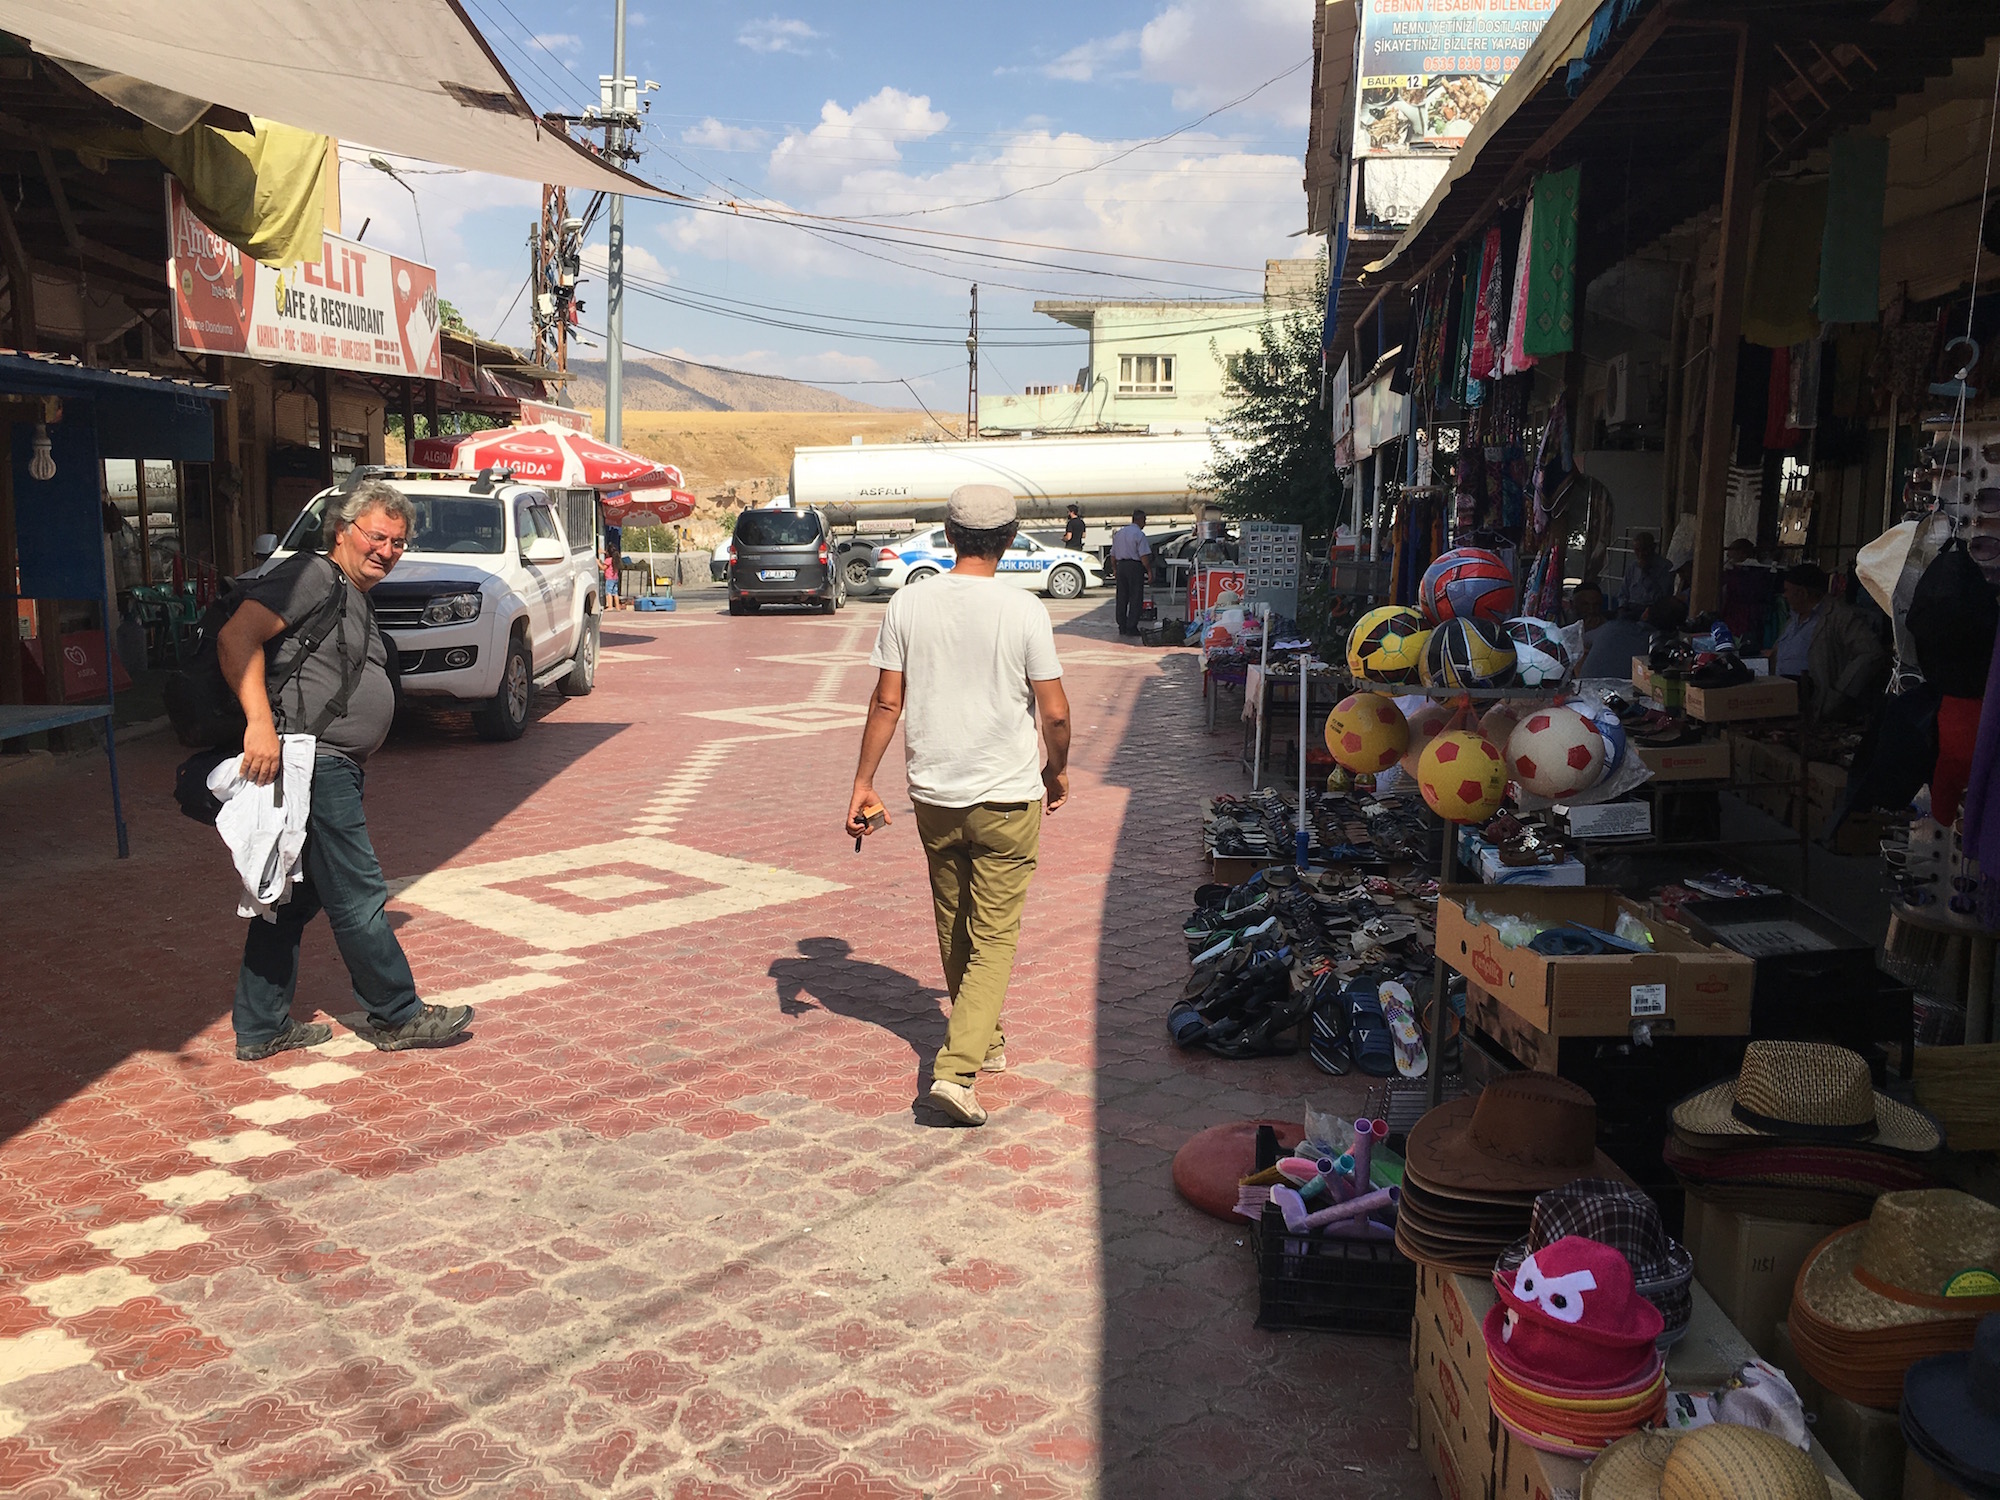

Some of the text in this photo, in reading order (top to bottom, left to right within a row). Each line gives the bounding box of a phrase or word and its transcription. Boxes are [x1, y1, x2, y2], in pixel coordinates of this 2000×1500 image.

[1392, 18, 1475, 34] MEMNUYETİNİZİ
[1374, 37, 1441, 56] ŞİKAYETİNİZİ
[1444, 36, 1488, 51] BİZLERE
[1423, 56, 1455, 72] 0535
[1458, 56, 1481, 71] 836
[1484, 56, 1501, 71] 93
[1367, 77, 1398, 86] BALIK
[1407, 75, 1420, 88] 12
[310, 294, 318, 323] &
[321, 297, 384, 335] RESTAURANT
[860, 486, 908, 496] ASFALT
[997, 559, 1042, 570] AFİK POLİS
